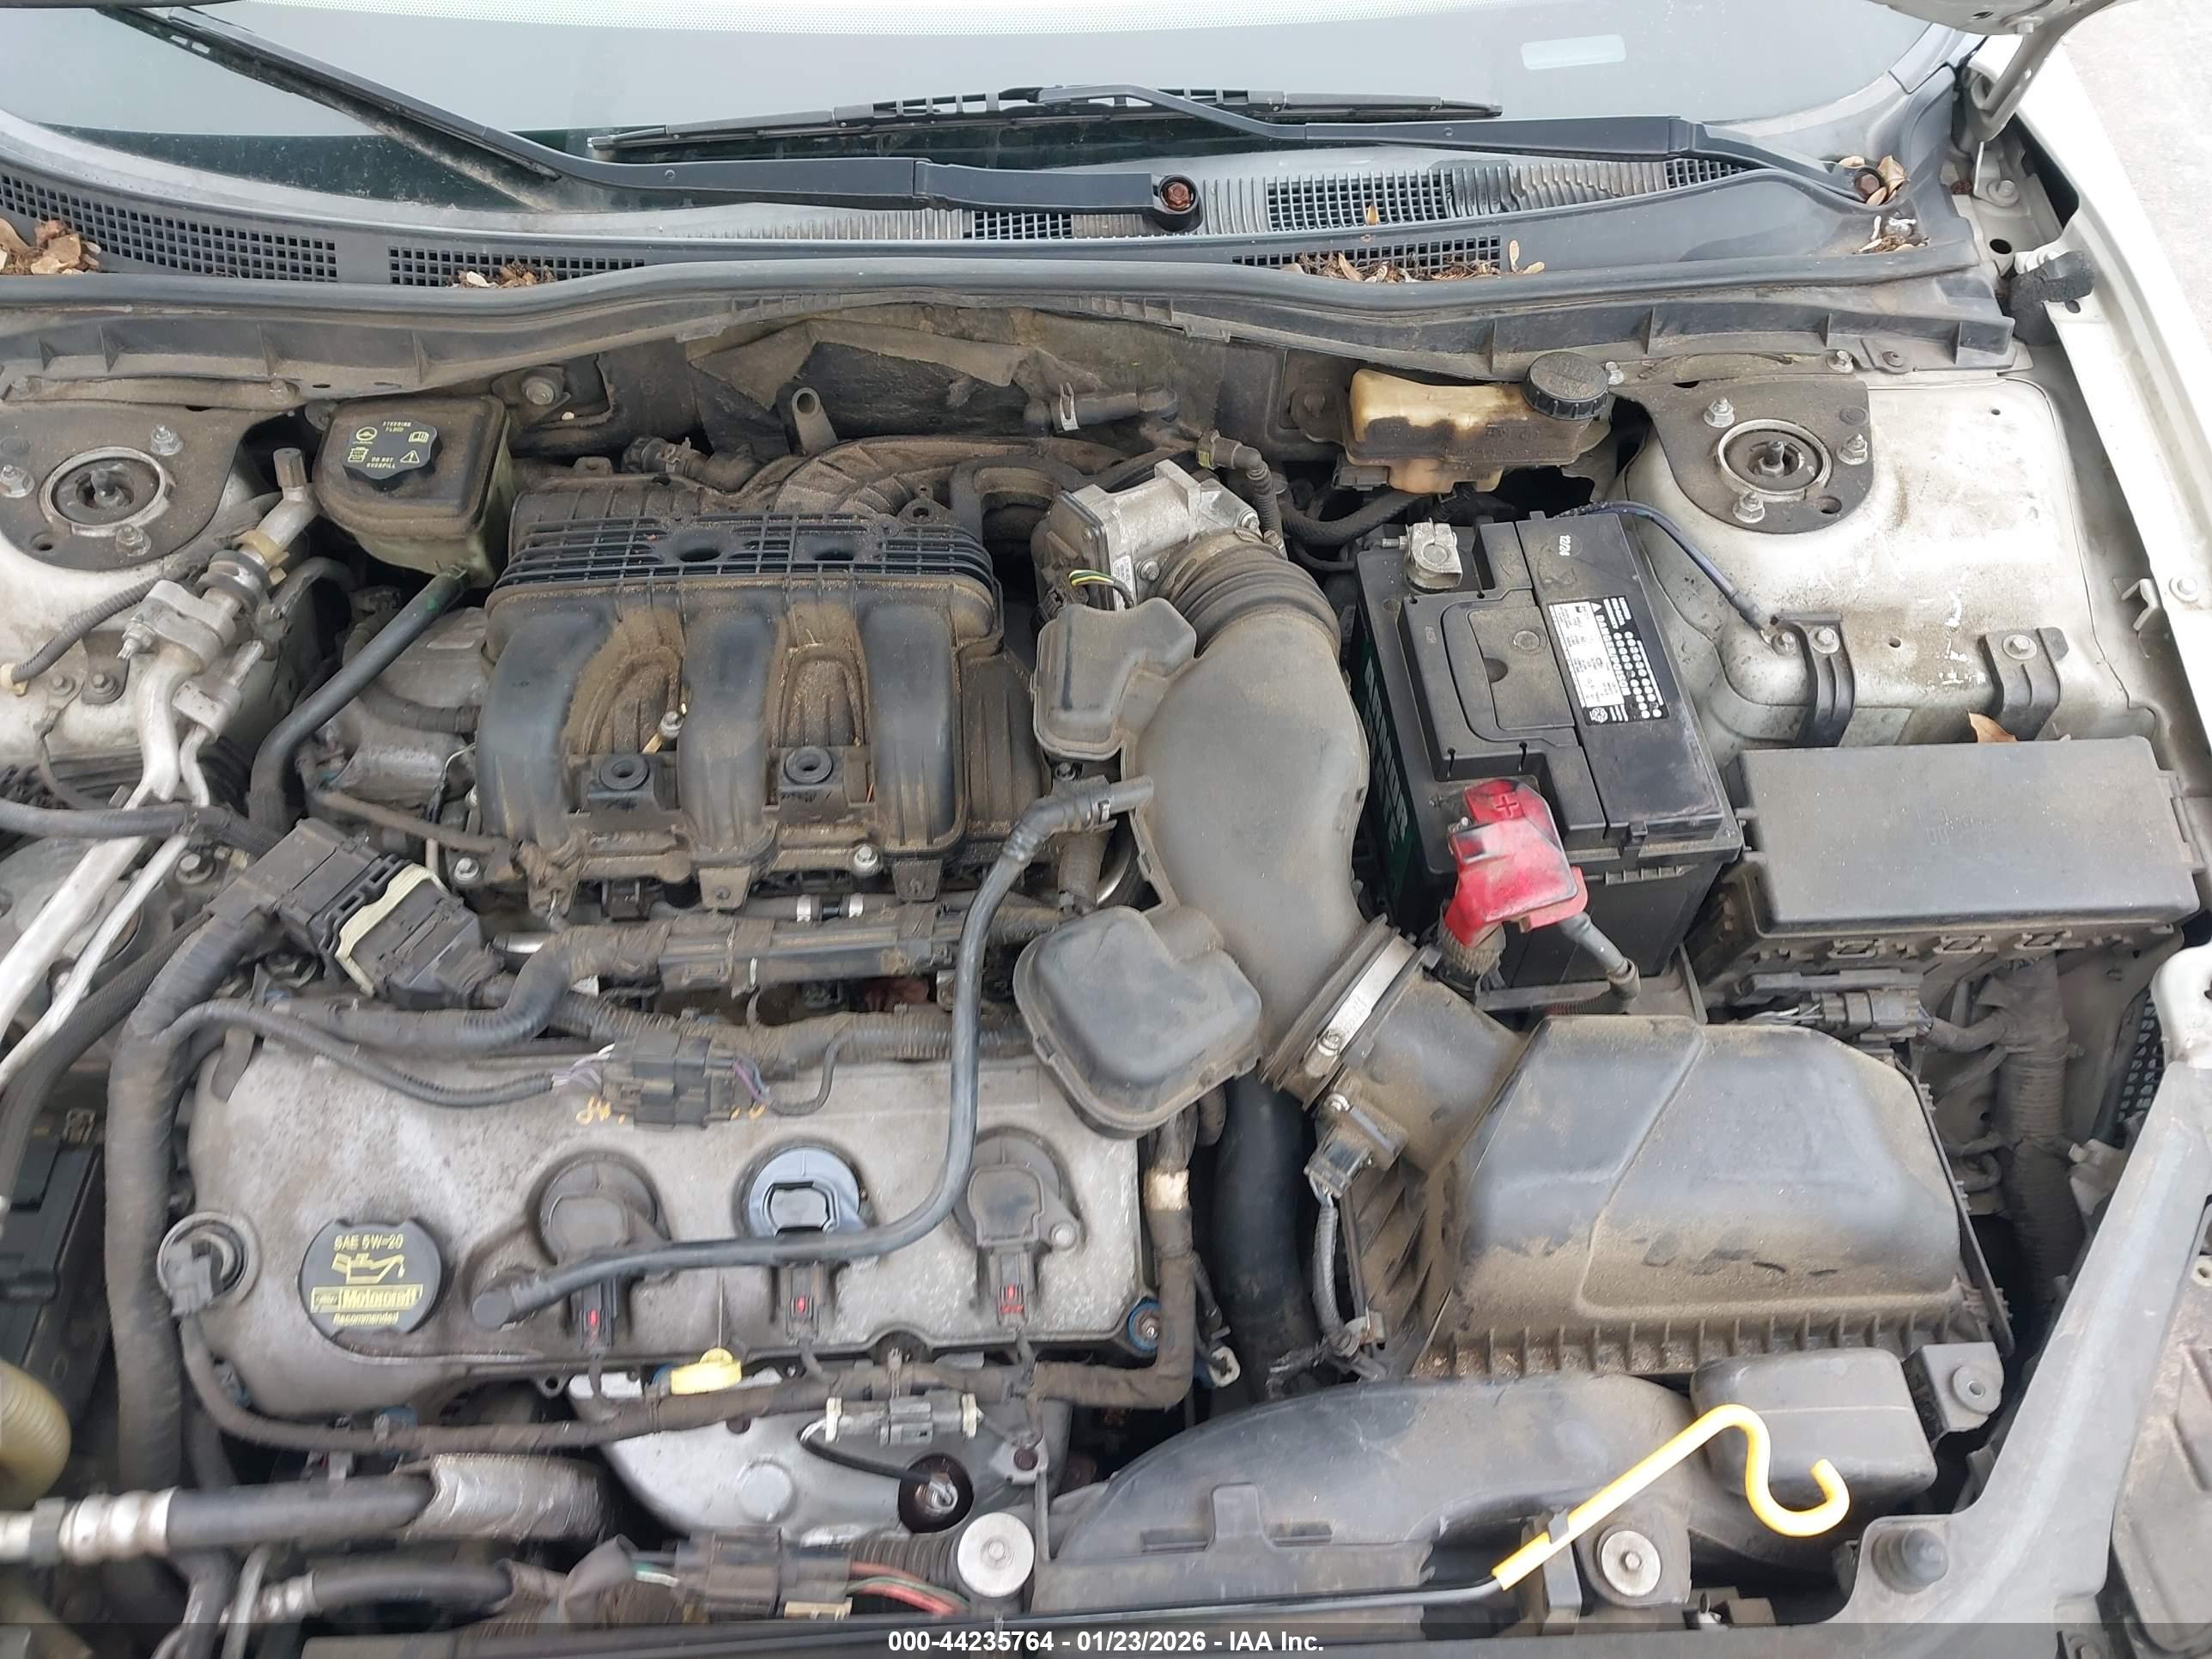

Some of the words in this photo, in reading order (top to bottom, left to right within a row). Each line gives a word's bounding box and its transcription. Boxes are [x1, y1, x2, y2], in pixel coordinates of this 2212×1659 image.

[1559, 534, 1571, 557] 12/24
[333, 1234, 359, 1251] SAE
[362, 1233, 404, 1250] 5W-20
[342, 1286, 417, 1310] Motorcraft
[332, 1310, 399, 1327] Recommended
